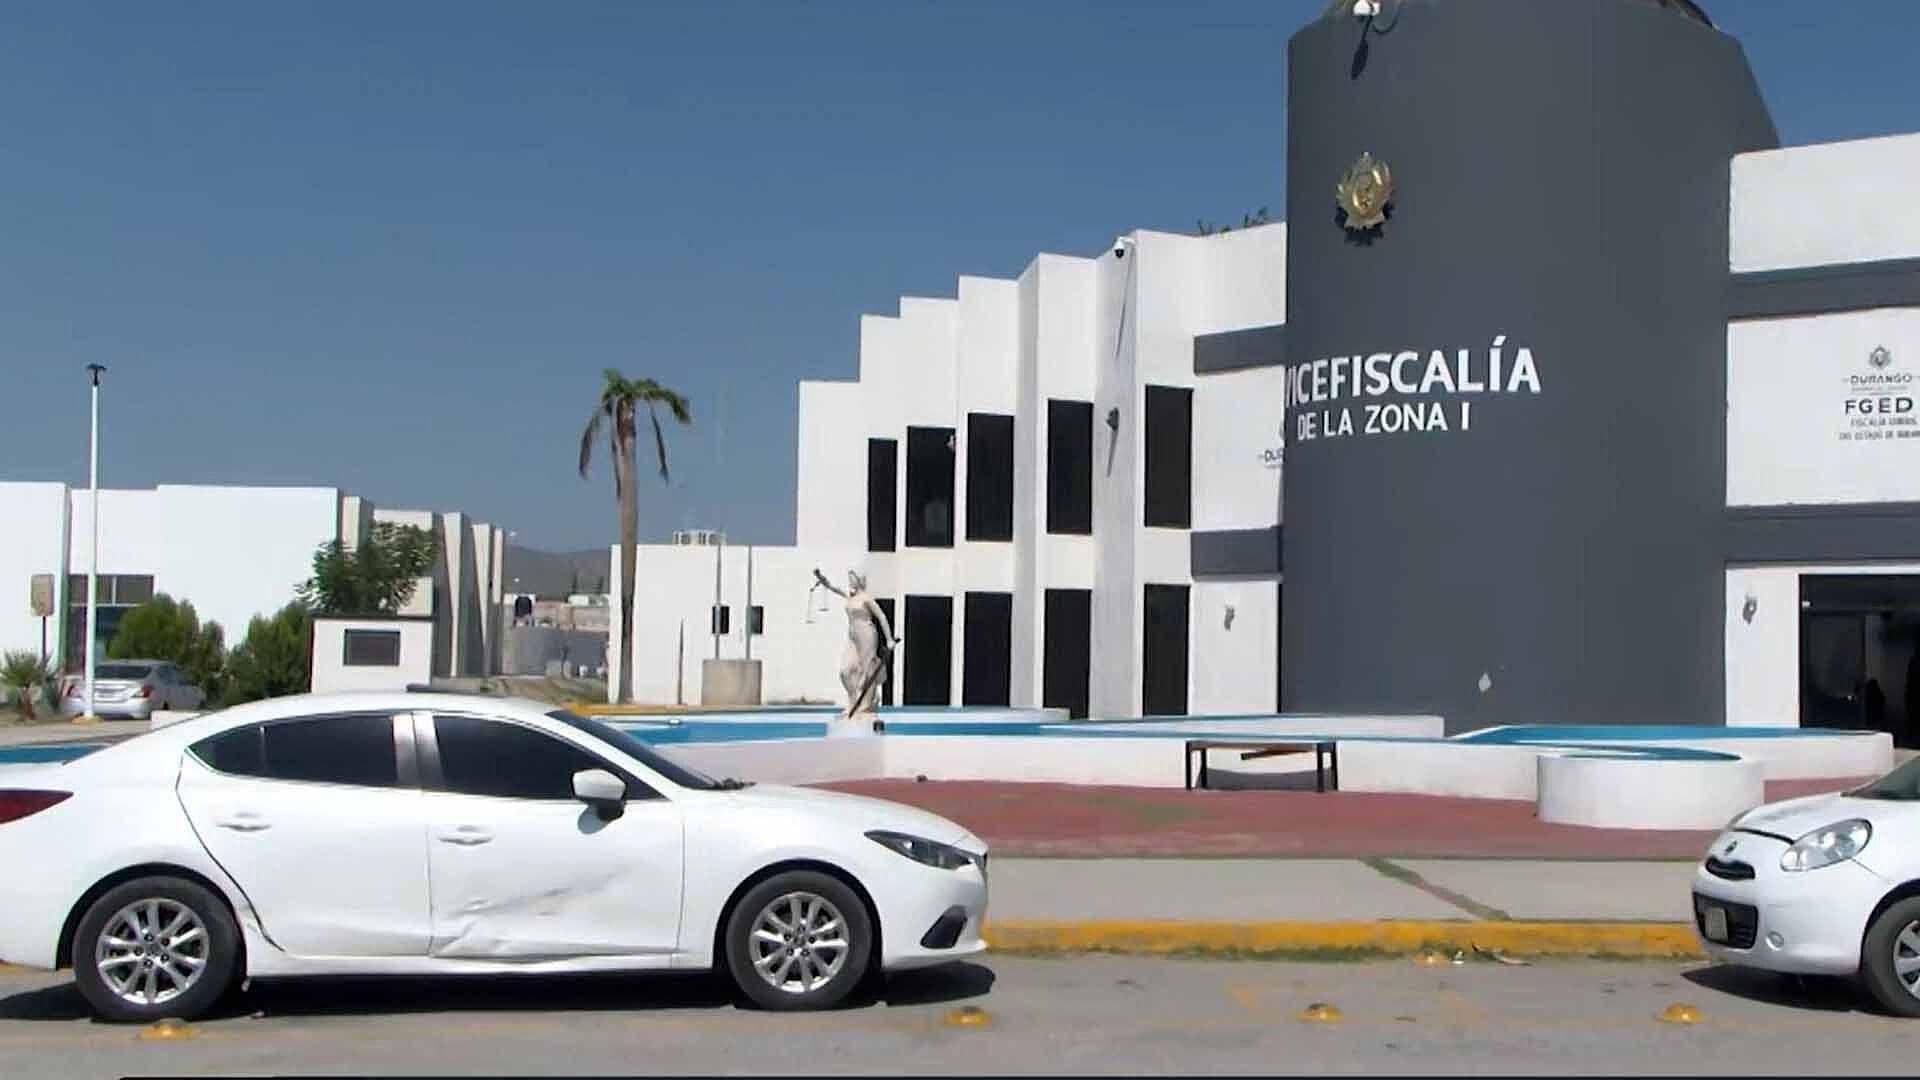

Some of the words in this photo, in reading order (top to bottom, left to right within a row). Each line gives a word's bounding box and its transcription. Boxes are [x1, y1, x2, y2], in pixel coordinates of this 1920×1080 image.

[1850, 374, 1913, 385] DURANGO
[1845, 397, 1913, 415] FGED
[1297, 411, 1318, 441] DE
[1324, 408, 1354, 438] LA
[1364, 402, 1448, 434] ZONA
[1460, 402, 1471, 431] I
